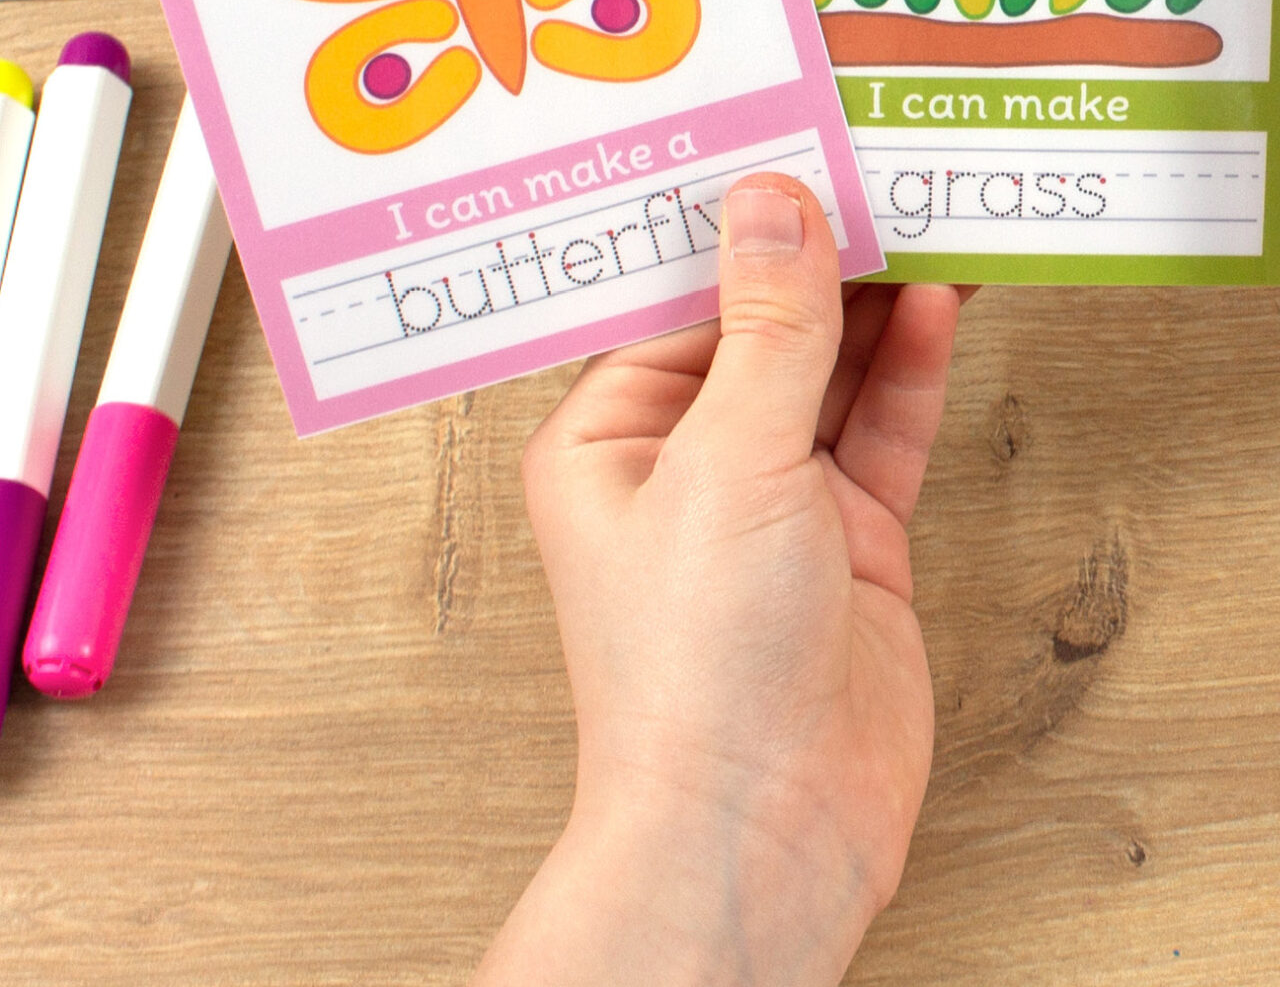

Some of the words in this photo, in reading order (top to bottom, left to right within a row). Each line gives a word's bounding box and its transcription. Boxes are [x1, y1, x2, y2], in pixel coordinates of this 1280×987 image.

[869, 82, 886, 119] I
[902, 91, 988, 121] can
[1003, 83, 1130, 122] make
[387, 202, 413, 241] I
[425, 186, 513, 231] can
[525, 142, 653, 204] make
[668, 127, 699, 159] a
[890, 169, 1107, 239] grass
